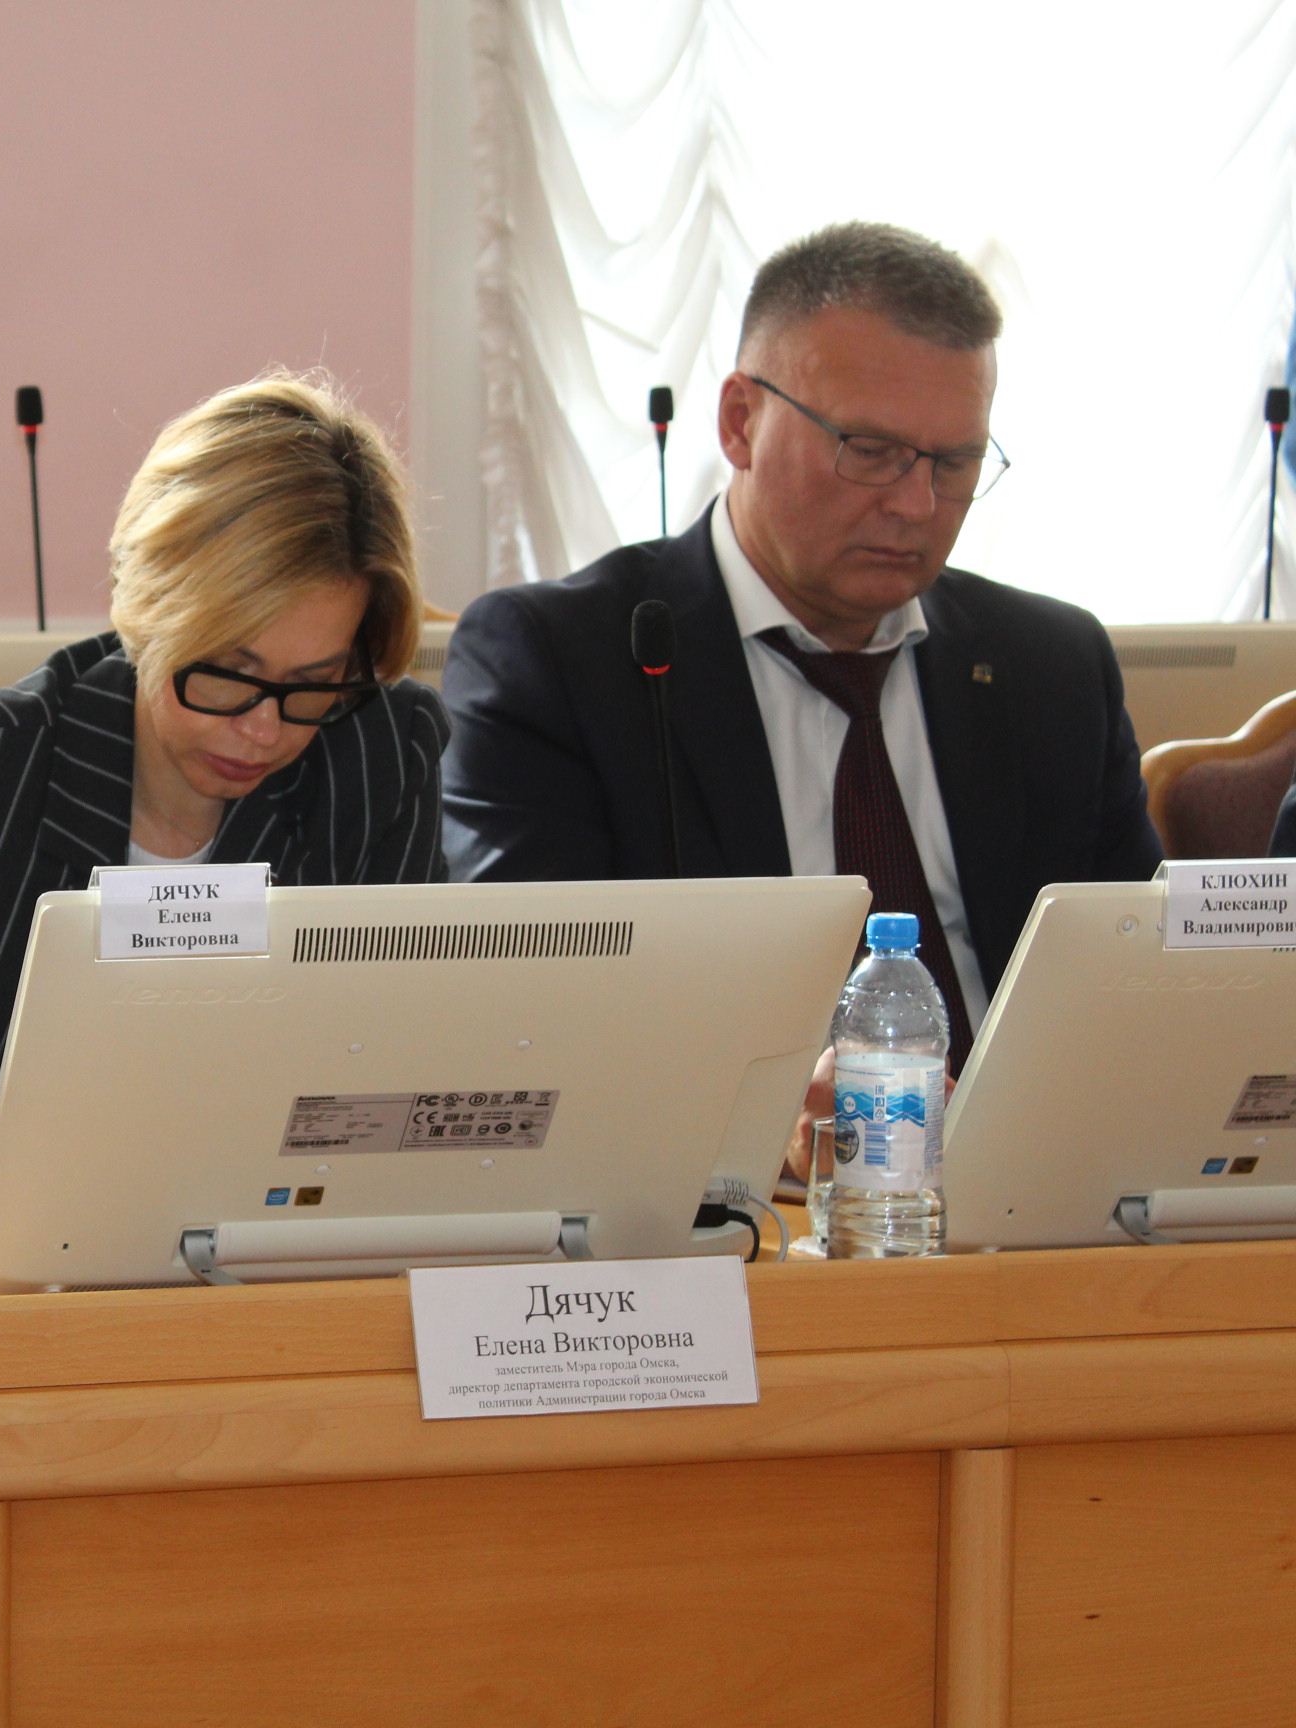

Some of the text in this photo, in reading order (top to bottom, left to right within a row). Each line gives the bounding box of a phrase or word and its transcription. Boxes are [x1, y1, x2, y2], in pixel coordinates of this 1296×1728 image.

[1201, 873, 1287, 890] КЛЮХИН
[147, 883, 220, 903] ДЯЧУК
[1200, 897, 1288, 914] Александр
[158, 908, 212, 924] Елена
[1183, 919, 1296, 937] Владимирови
[131, 933, 239, 951] Викторовна
[525, 1284, 637, 1325] Дячук
[474, 1331, 695, 1357] Елена Викторовна
[494, 1357, 680, 1376] заместитель Мэра города Омска,
[448, 1369, 728, 1396] директор департамента городской экономической
[478, 1387, 706, 1409] политики Администрации города Омска
